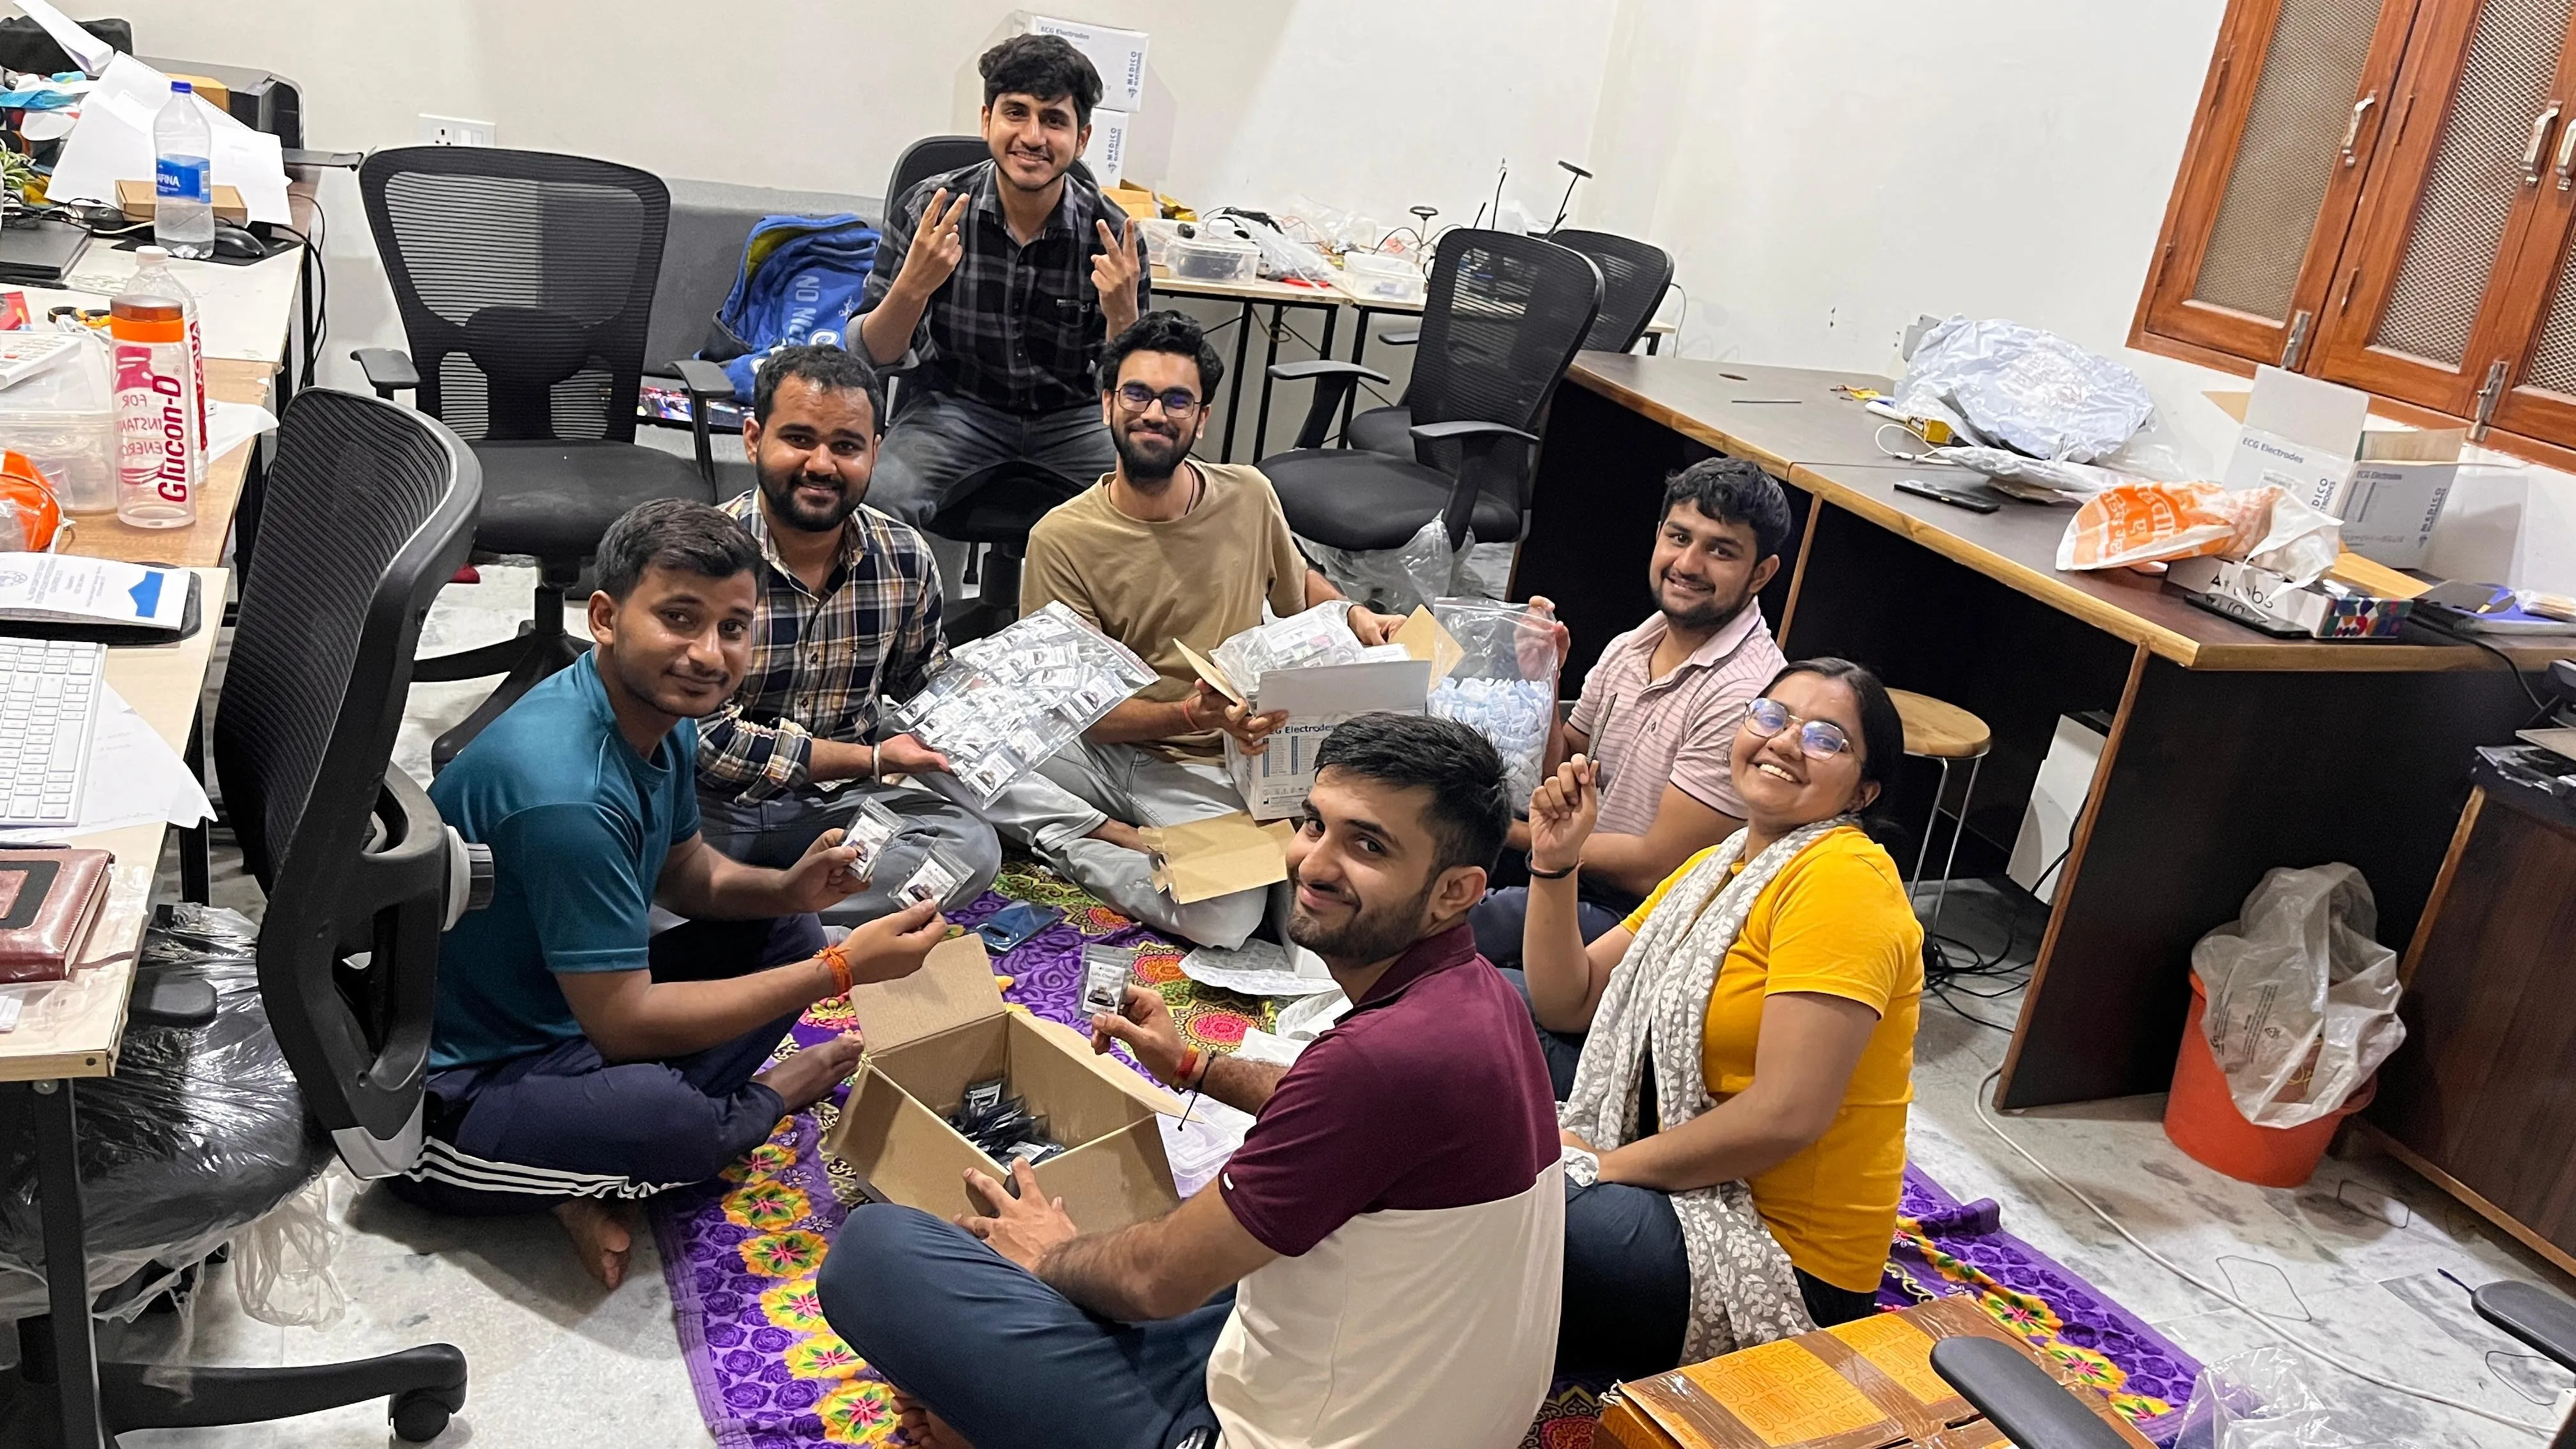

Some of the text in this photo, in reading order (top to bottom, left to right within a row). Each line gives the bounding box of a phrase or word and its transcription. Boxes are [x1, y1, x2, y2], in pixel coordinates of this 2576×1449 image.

[1041, 26, 1090, 40] ECG Electrodes
[1126, 51, 1137, 86] MEDICO
[1107, 127, 1117, 161] MEDICO
[795, 275, 819, 302] NO
[152, 376, 187, 502] Glucon-D
[2242, 437, 2304, 463] ECG Electrodes
[2312, 479, 2327, 507] DICO
